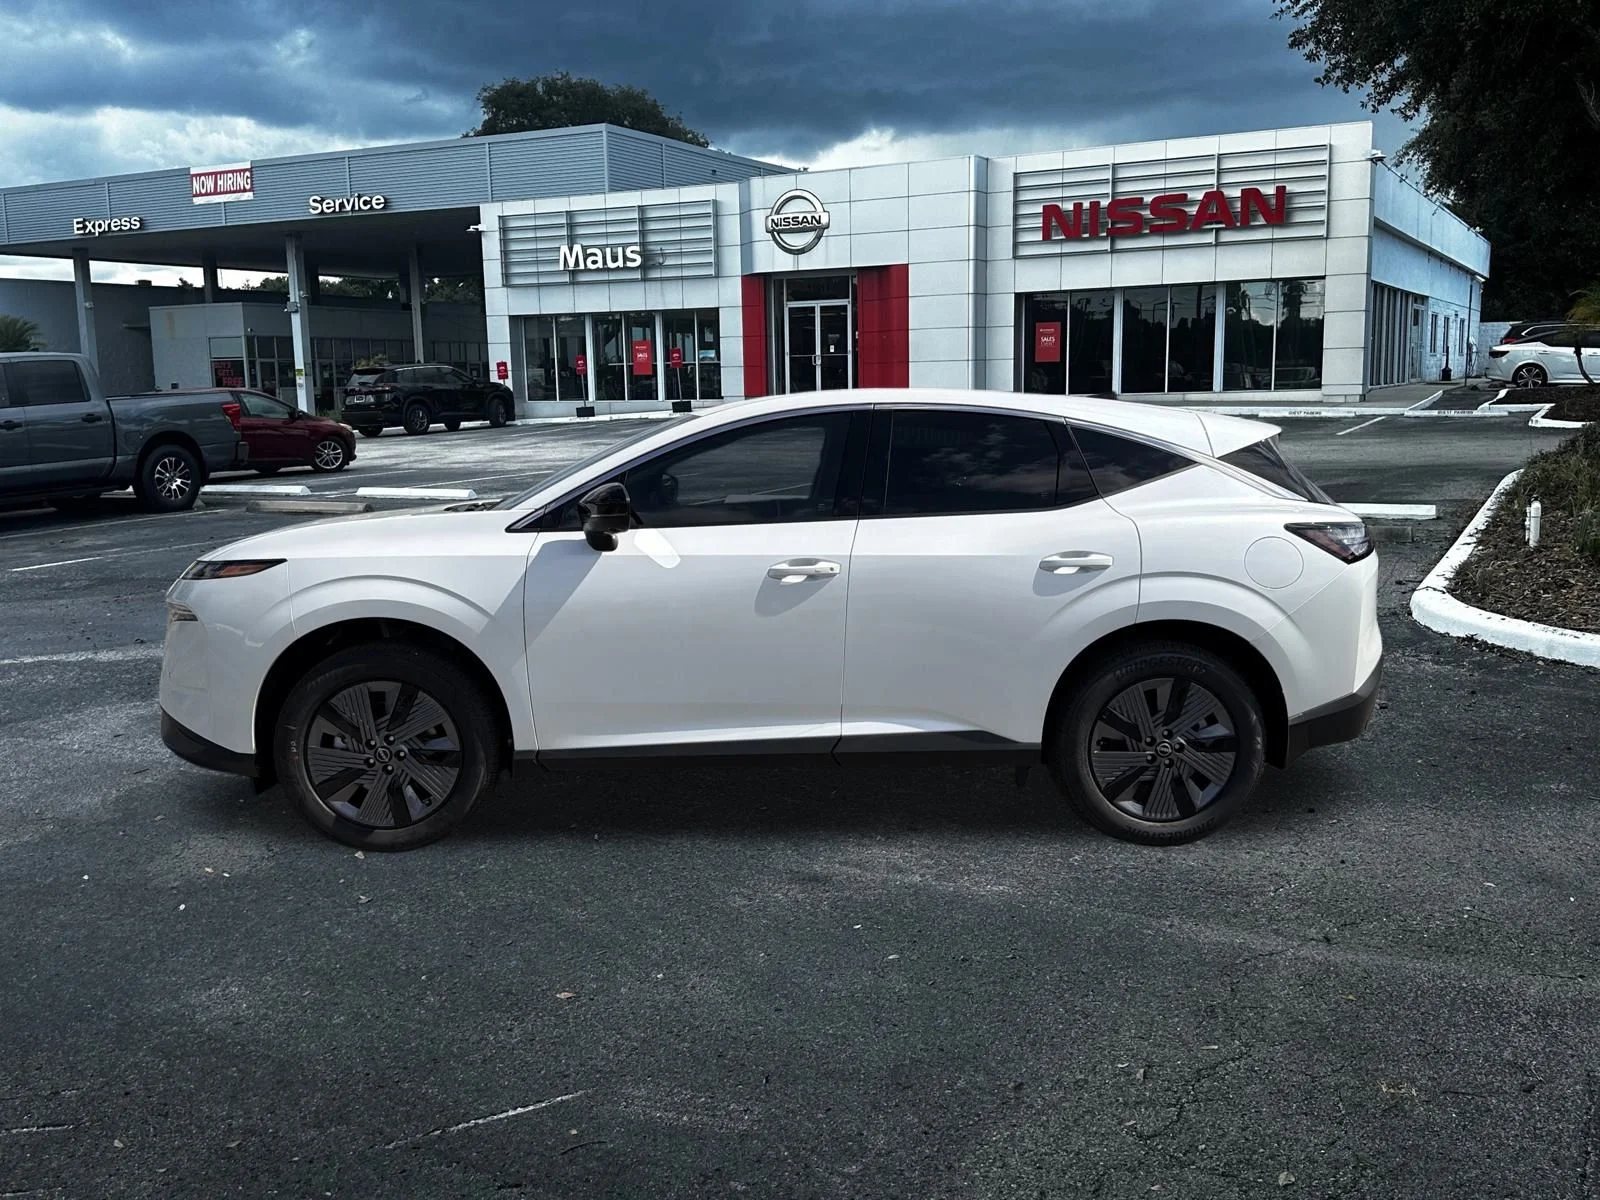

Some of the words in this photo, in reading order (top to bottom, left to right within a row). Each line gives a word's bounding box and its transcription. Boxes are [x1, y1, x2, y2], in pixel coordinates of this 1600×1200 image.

[193, 175, 215, 194] NOW
[217, 171, 251, 192] HIRING
[309, 193, 385, 214] Service
[1042, 186, 1287, 240] NISSAN
[73, 216, 141, 236] Express
[771, 215, 821, 228] NISSAN
[560, 243, 642, 270] Maus
